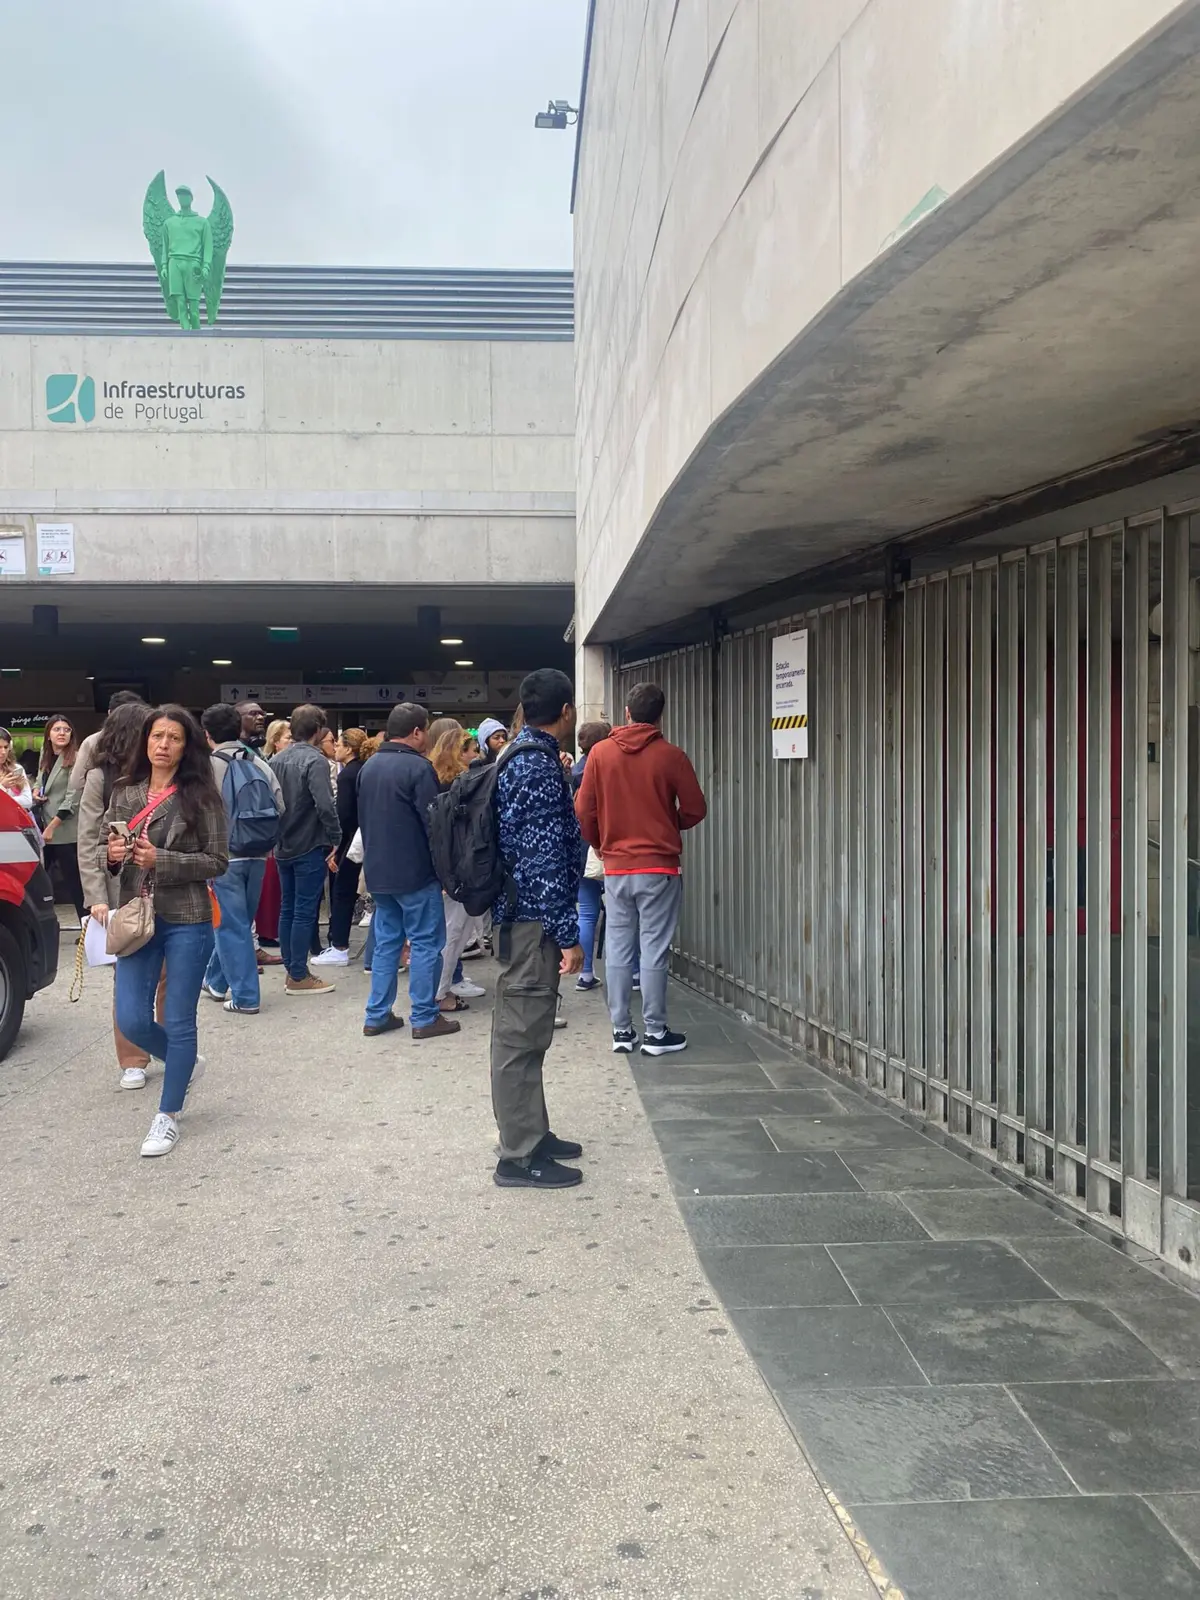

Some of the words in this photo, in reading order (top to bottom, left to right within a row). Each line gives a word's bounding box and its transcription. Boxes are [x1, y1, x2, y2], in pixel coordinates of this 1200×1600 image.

[103, 381, 245, 399] Infraestruturas
[104, 403, 124, 419] de
[135, 403, 204, 423] Portugal
[10, 716, 31, 727] pingo
[32, 714, 49, 722] doce
